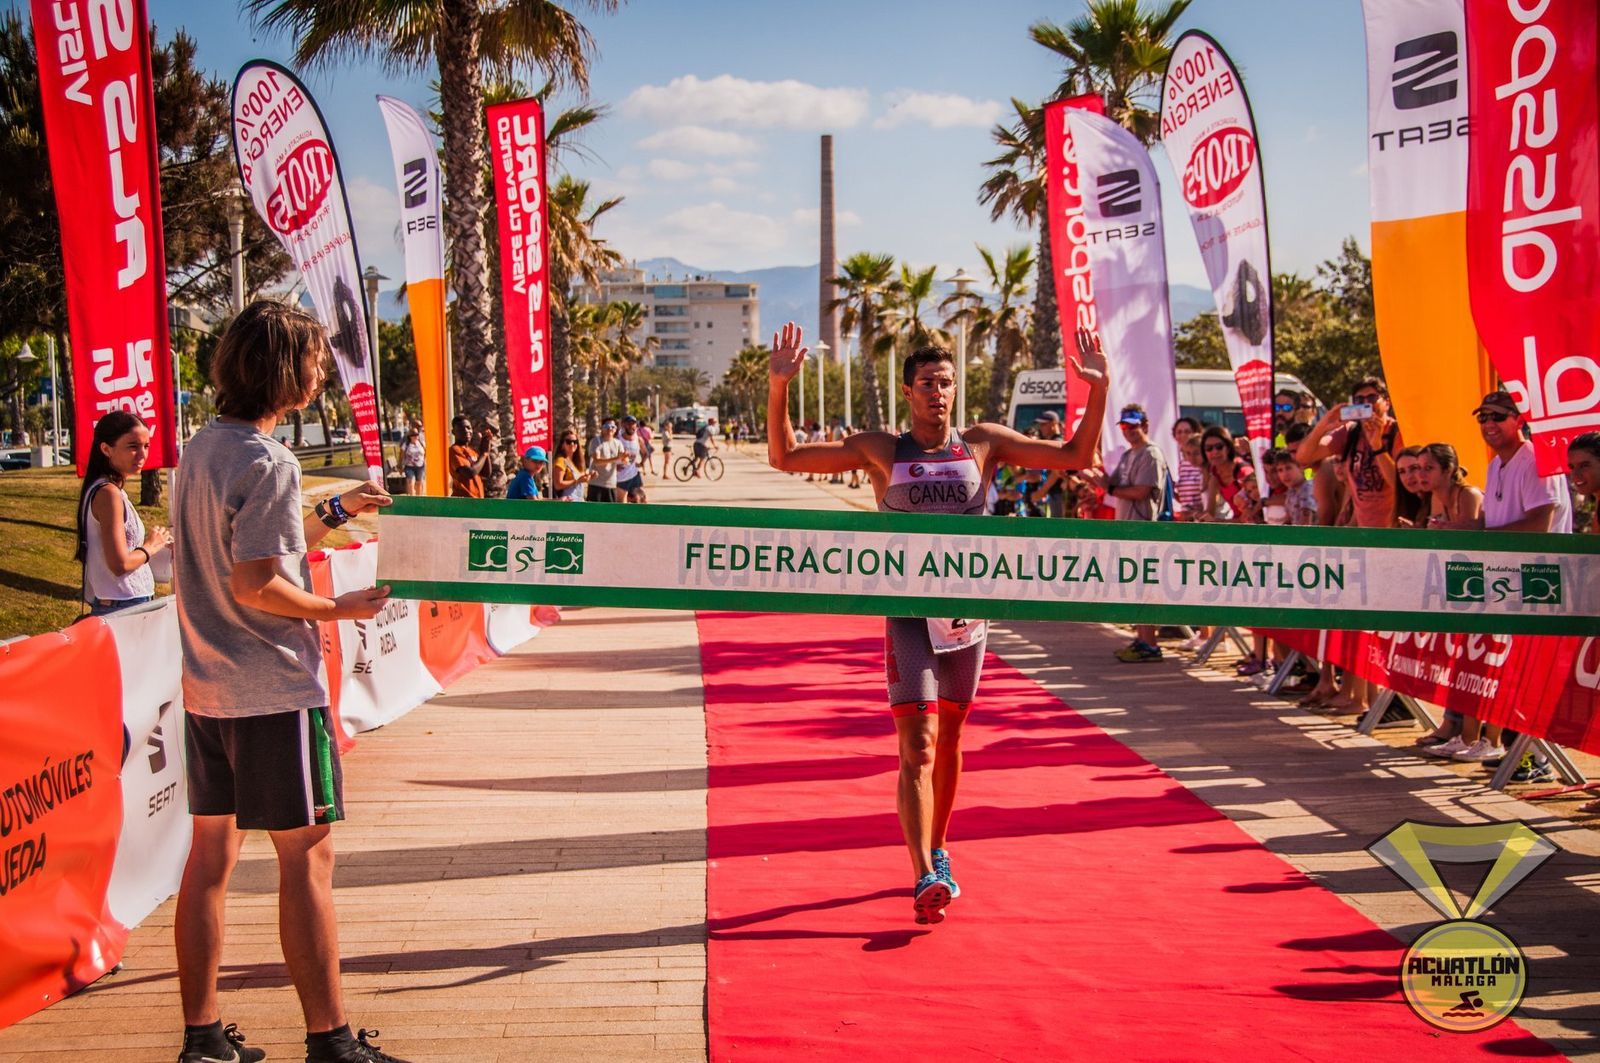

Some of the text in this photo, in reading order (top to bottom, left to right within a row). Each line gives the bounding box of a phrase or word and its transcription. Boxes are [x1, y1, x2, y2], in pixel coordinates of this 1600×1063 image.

[909, 481, 967, 505] CAÑAS
[510, 534, 545, 542] Andaluza
[685, 542, 1345, 591] FEDERACION ANDALUZA DE TRIATLON
[147, 781, 177, 818] SEAT
